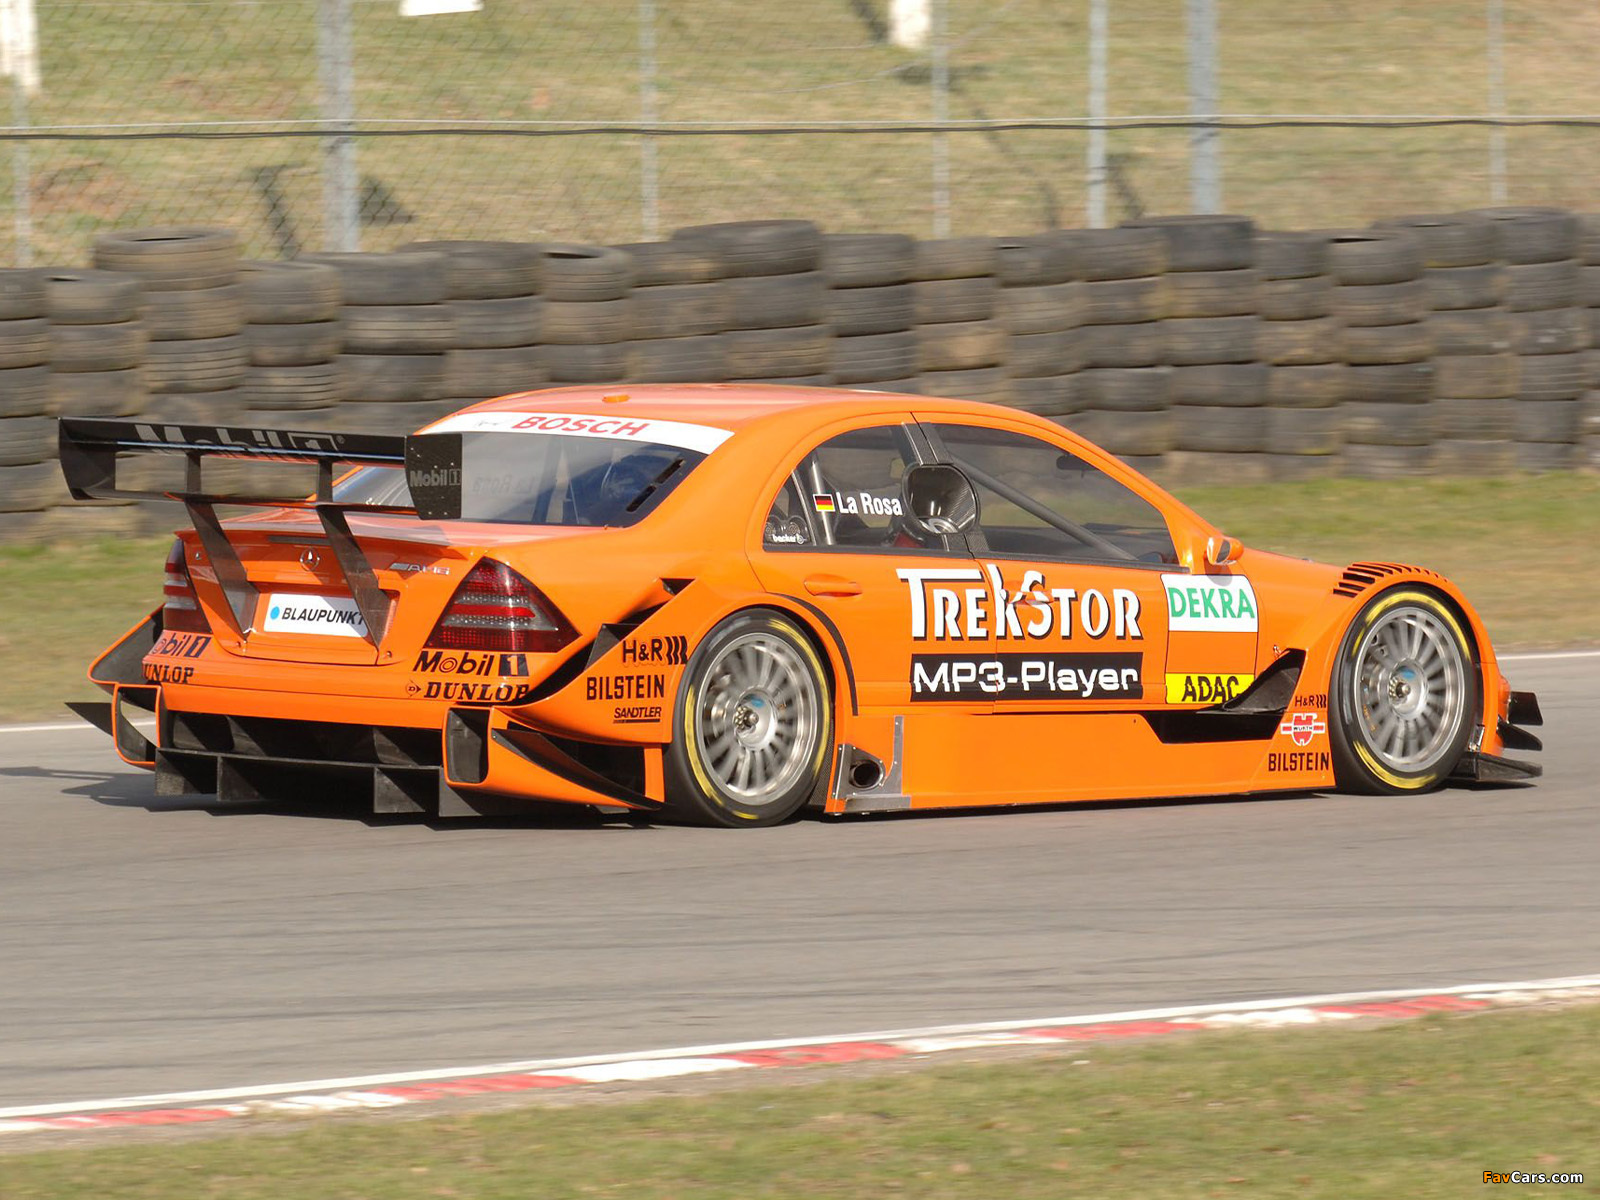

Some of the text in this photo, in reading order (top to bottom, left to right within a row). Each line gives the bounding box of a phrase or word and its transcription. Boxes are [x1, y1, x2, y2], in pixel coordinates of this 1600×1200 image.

[511, 416, 650, 436] BOSCH
[410, 469, 448, 487] Mobil
[836, 492, 903, 516] La Rosa
[1168, 587, 1255, 618] DEKRA
[281, 607, 365, 626] BLAUPUNKT
[622, 639, 663, 663] H&R
[143, 663, 194, 684] UNLOP
[412, 650, 494, 676] Mobil
[587, 675, 664, 700] BILSTEIN
[913, 661, 1138, 697] MP3-Player
[1181, 676, 1239, 703] ADAC
[423, 682, 529, 702] DUNLOP
[1294, 695, 1315, 708] H&R
[614, 707, 661, 719] SANDTLER
[1268, 752, 1329, 772] BILSTEIN
